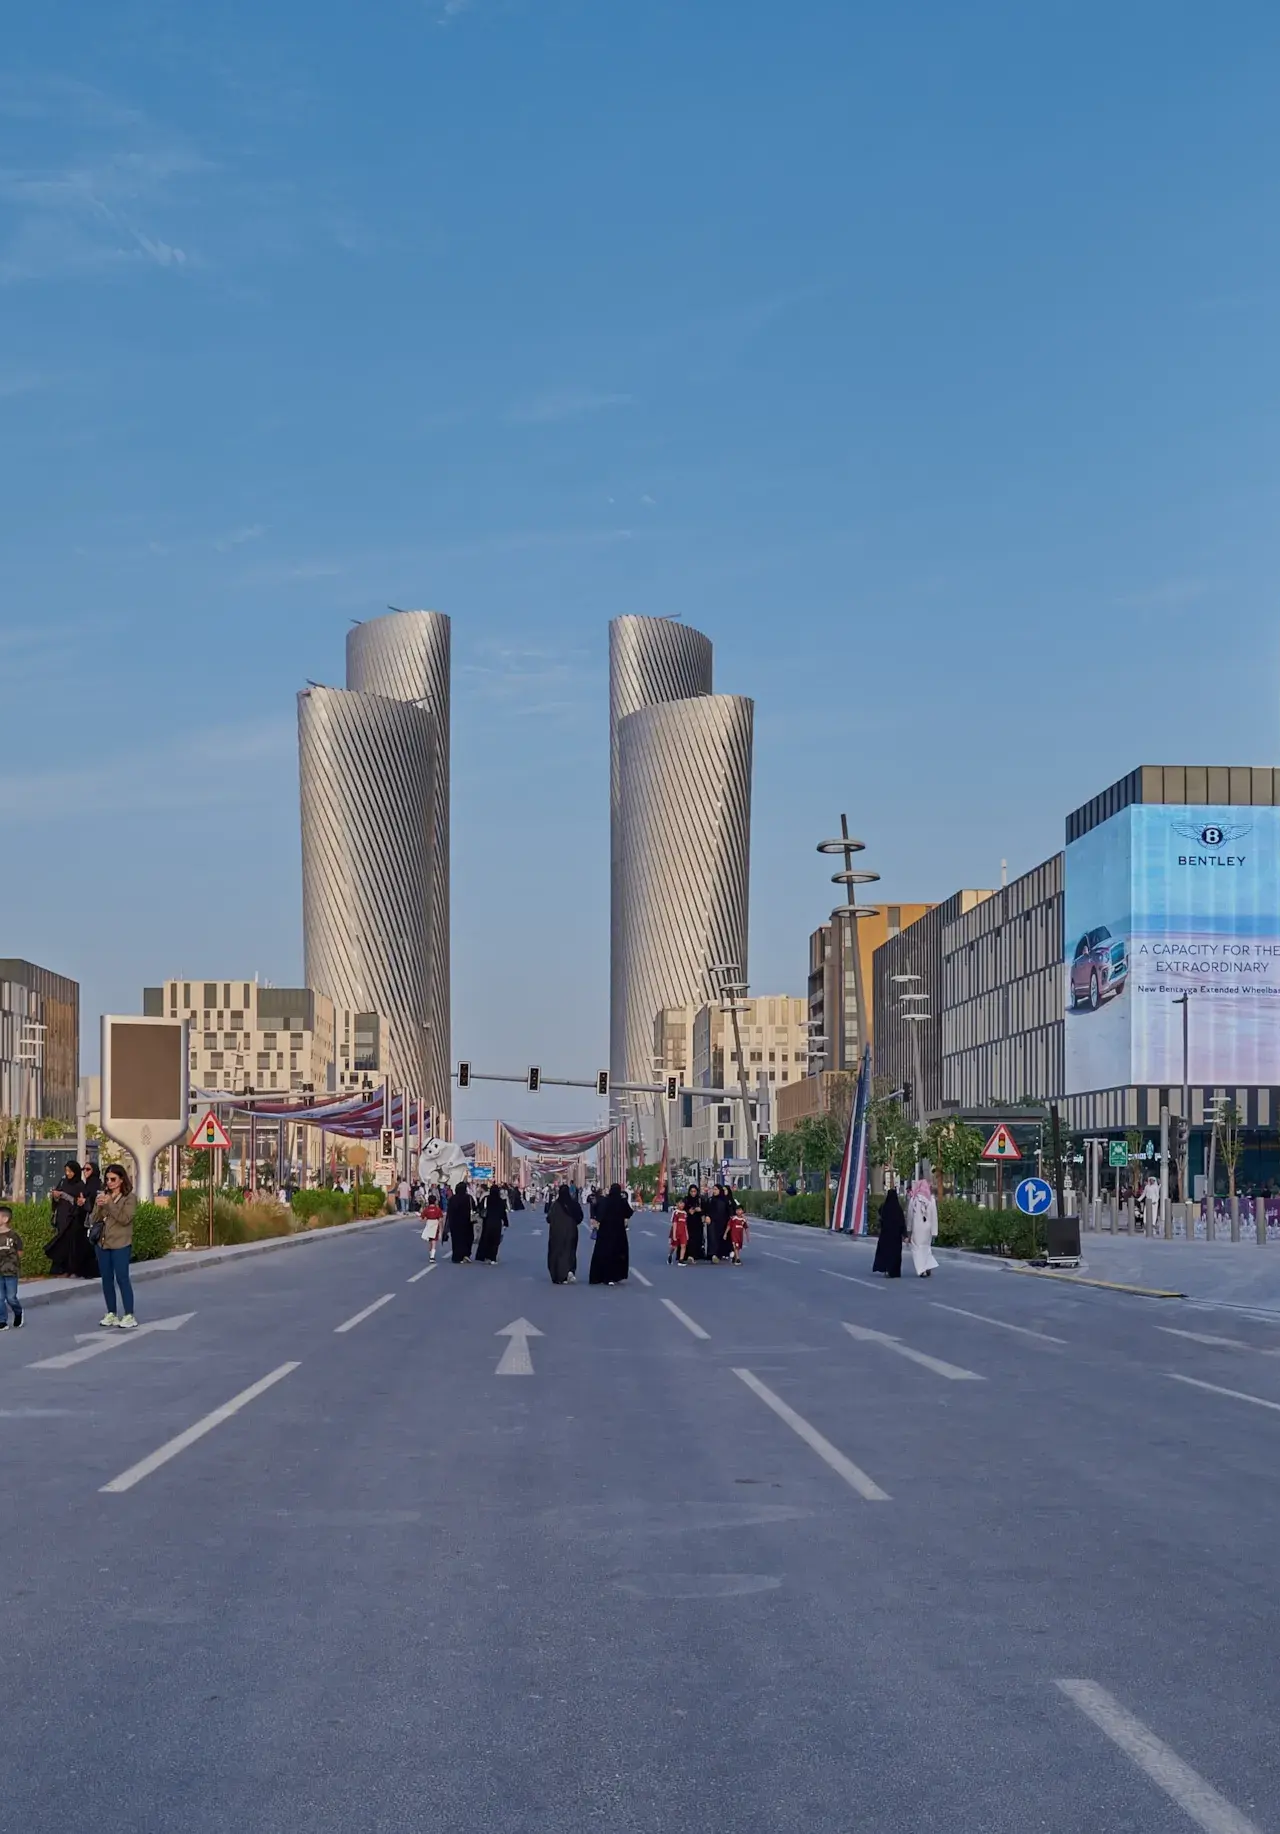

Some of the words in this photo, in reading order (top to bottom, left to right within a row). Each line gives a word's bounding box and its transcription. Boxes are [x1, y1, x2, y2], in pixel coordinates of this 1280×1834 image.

[1178, 856, 1246, 866] BENTLEY
[1140, 944, 1148, 954] A
[1152, 944, 1218, 955] CAPACITY
[1223, 944, 1250, 955] FOR
[1156, 961, 1269, 972] EXTRAORDINARY
[1137, 985, 1156, 993] New
[1200, 985, 1239, 993] Extended
